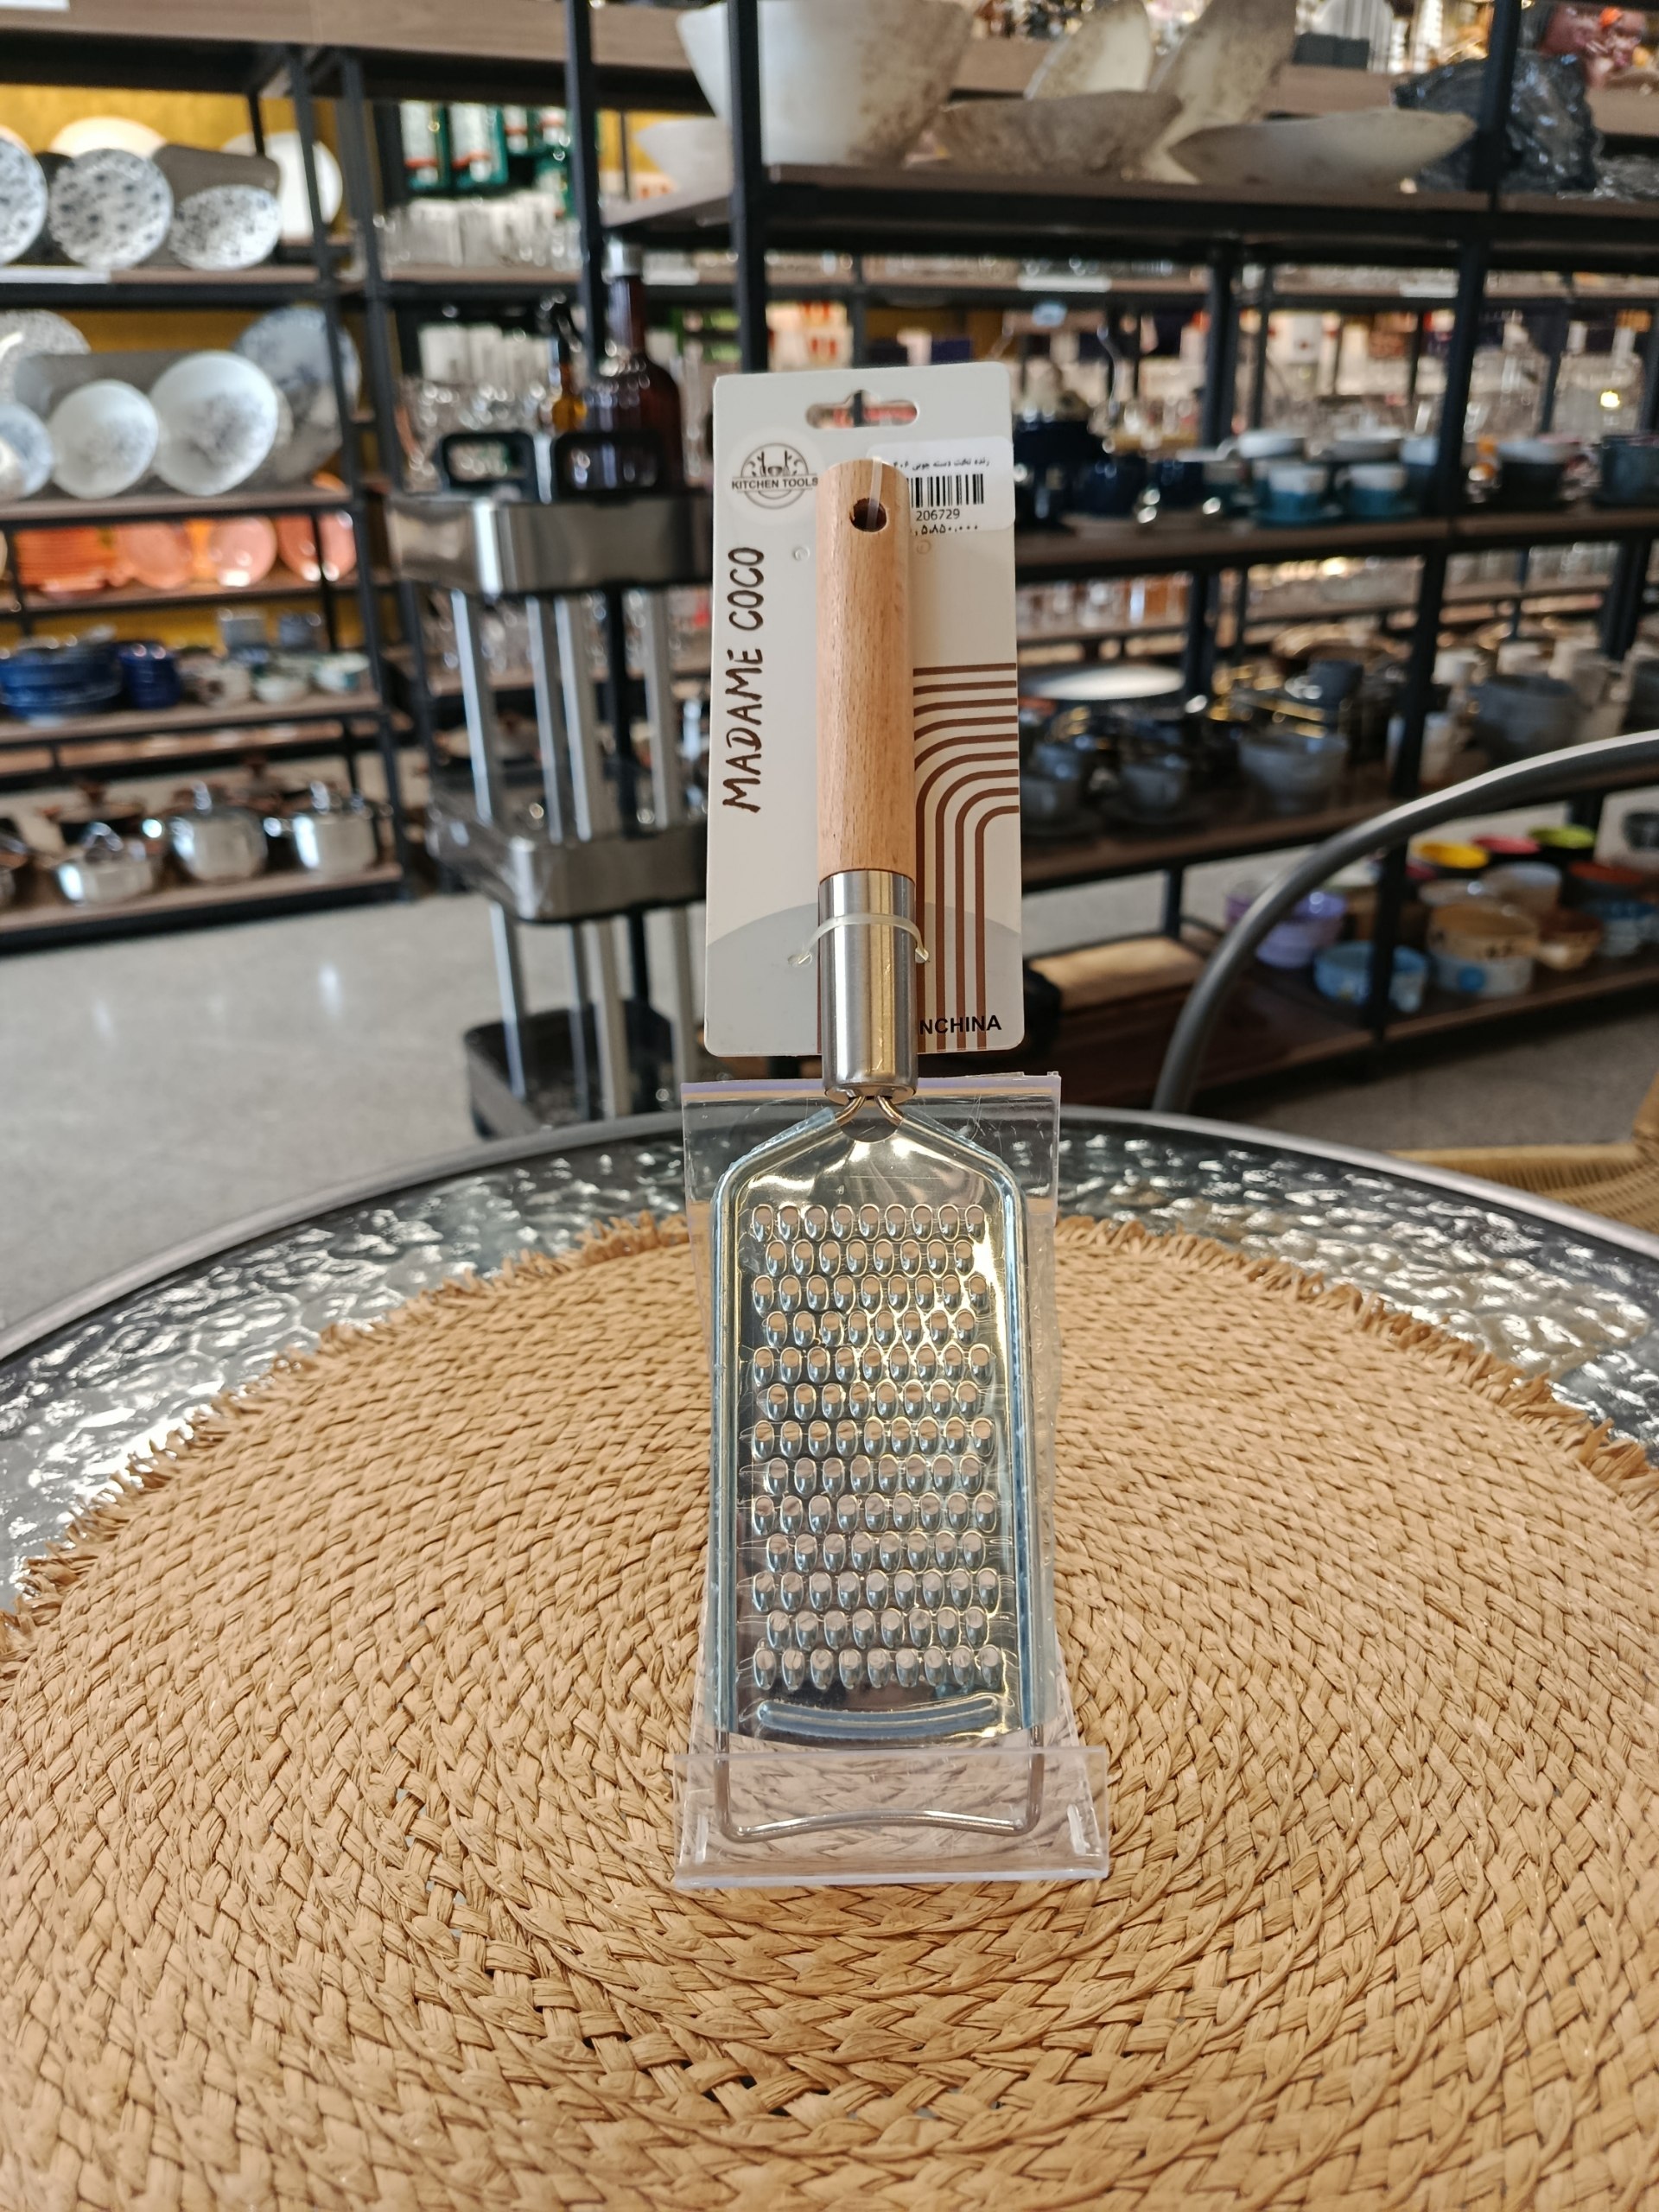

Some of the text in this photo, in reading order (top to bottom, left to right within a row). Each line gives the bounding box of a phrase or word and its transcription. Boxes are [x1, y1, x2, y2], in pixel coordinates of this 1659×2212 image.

[732, 477, 818, 490] KITCHEN TOOLS
[916, 508, 960, 522] 206729
[722, 547, 764, 813] MADAME COCO
